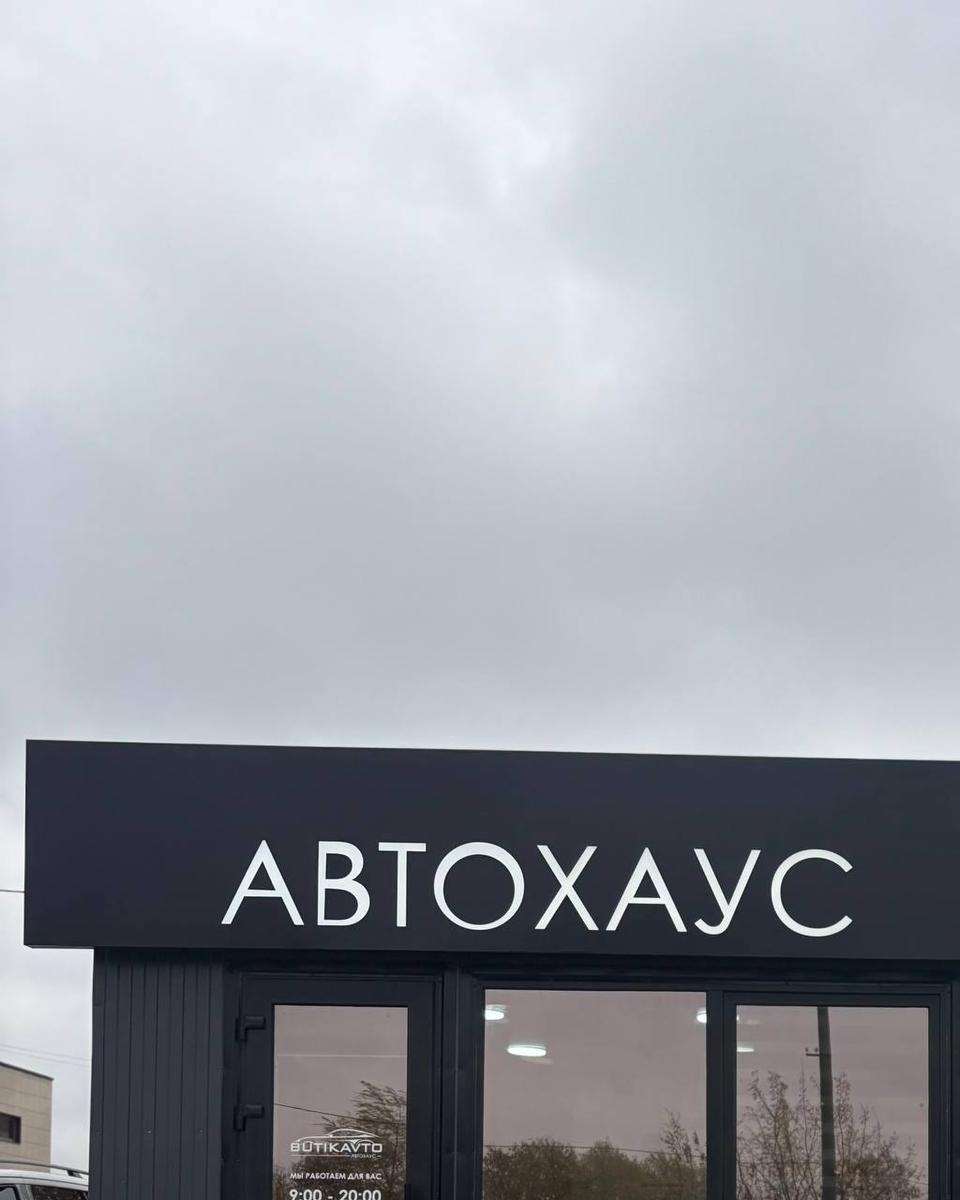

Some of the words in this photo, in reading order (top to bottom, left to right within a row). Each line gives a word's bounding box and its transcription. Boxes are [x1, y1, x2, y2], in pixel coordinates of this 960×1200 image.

[221, 839, 854, 938] АВТОХАУС
[290, 1142, 383, 1153] BUTIKAVTO
[347, 1173, 363, 1181] ДЛЯ
